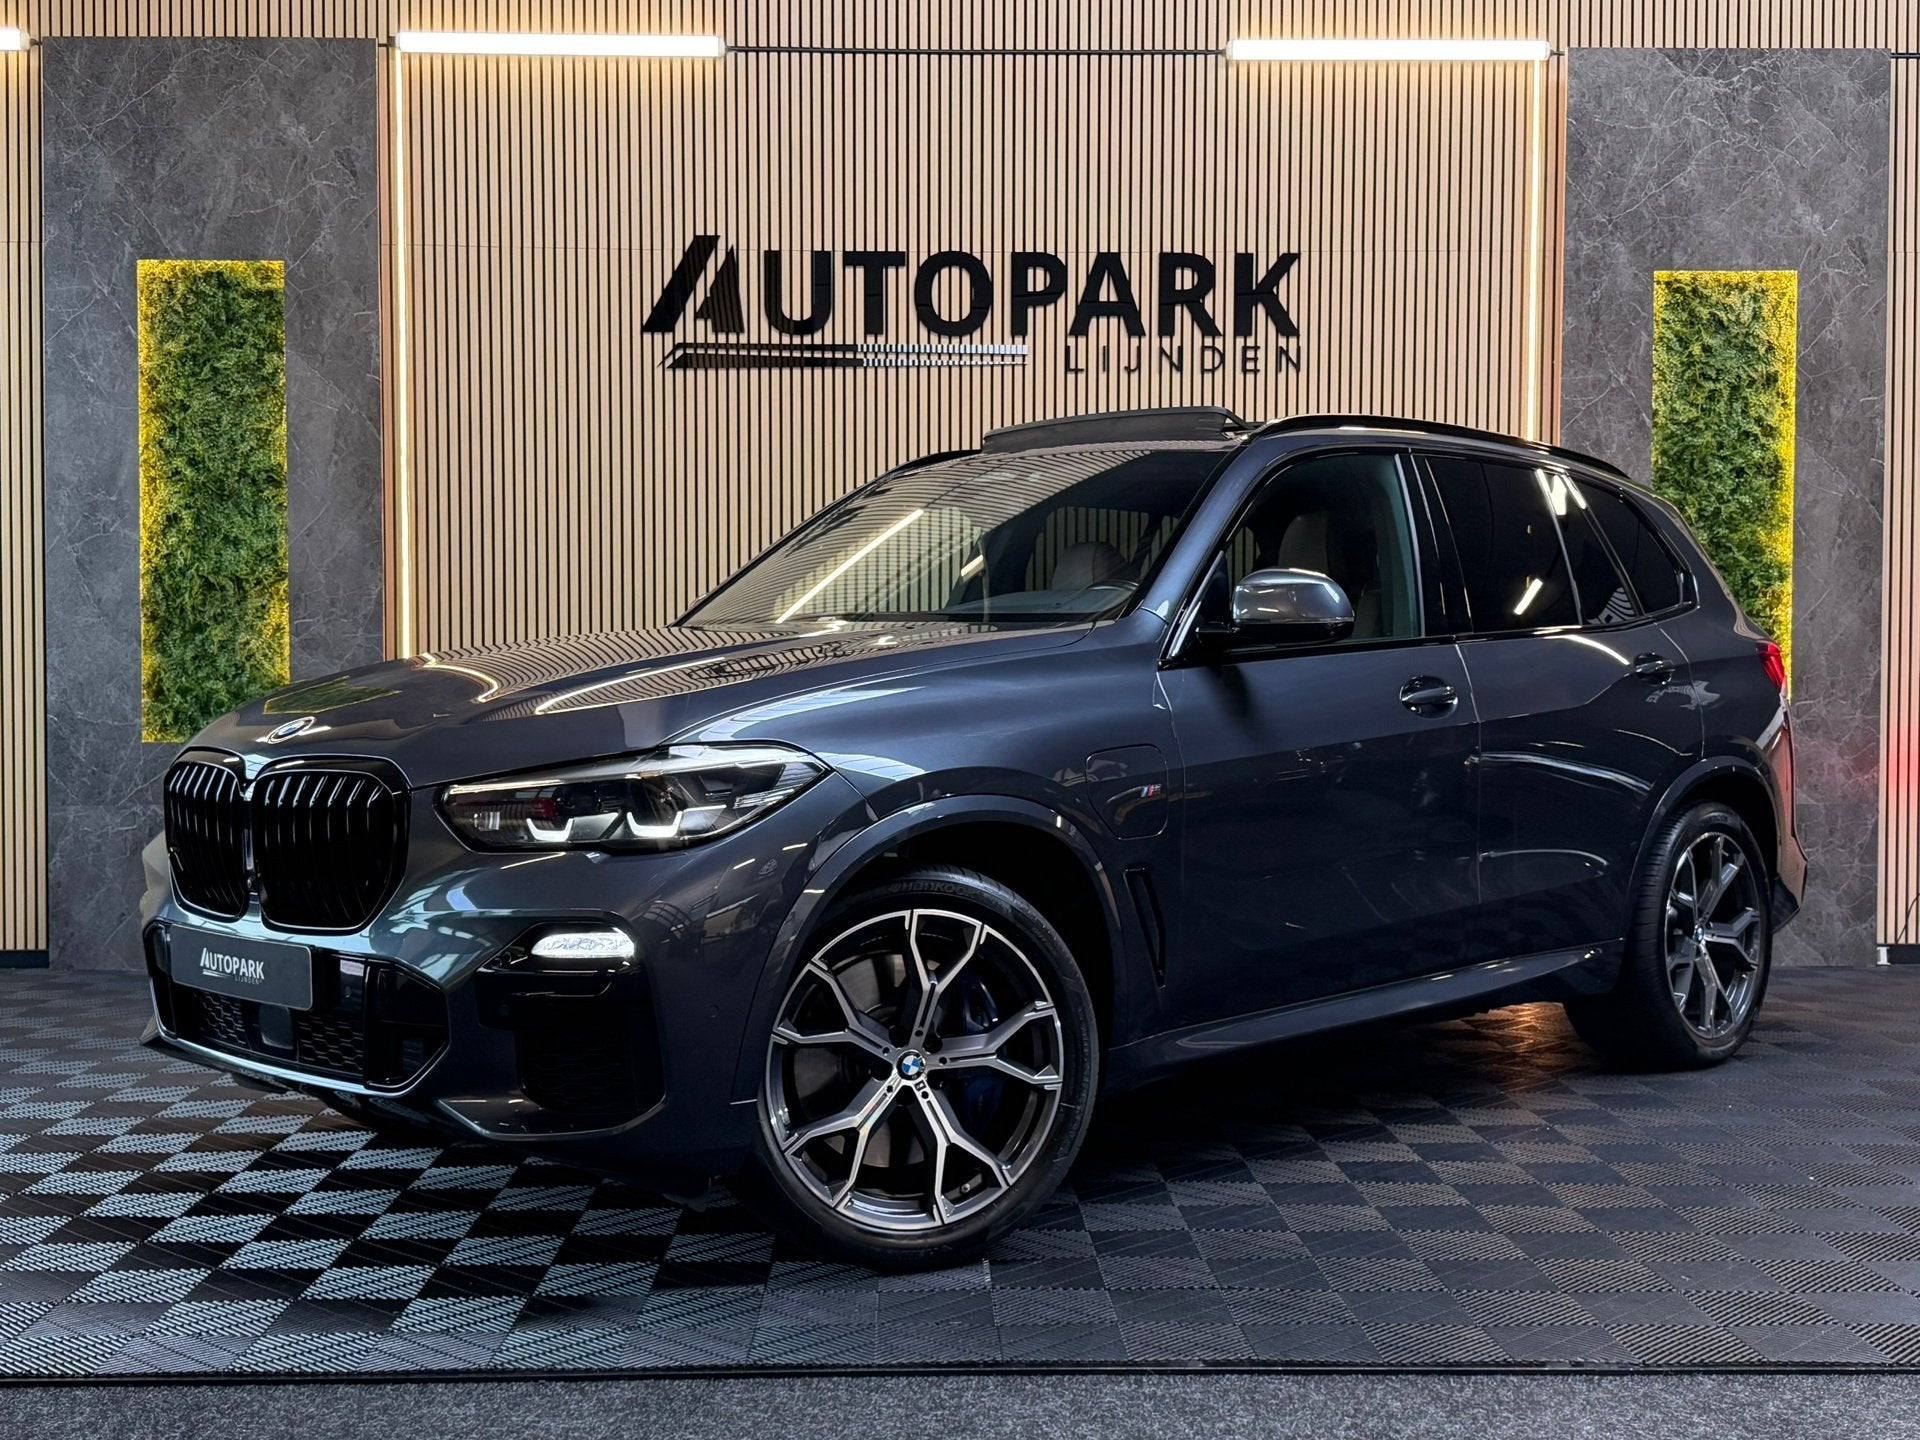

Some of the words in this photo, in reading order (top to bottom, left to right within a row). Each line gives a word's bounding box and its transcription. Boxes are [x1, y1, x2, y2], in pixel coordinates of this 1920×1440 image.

[641, 235, 1301, 337] AUTOPARK
[1065, 345, 1301, 373] LIJNDEN
[200, 947, 264, 979] AUTOPARK
